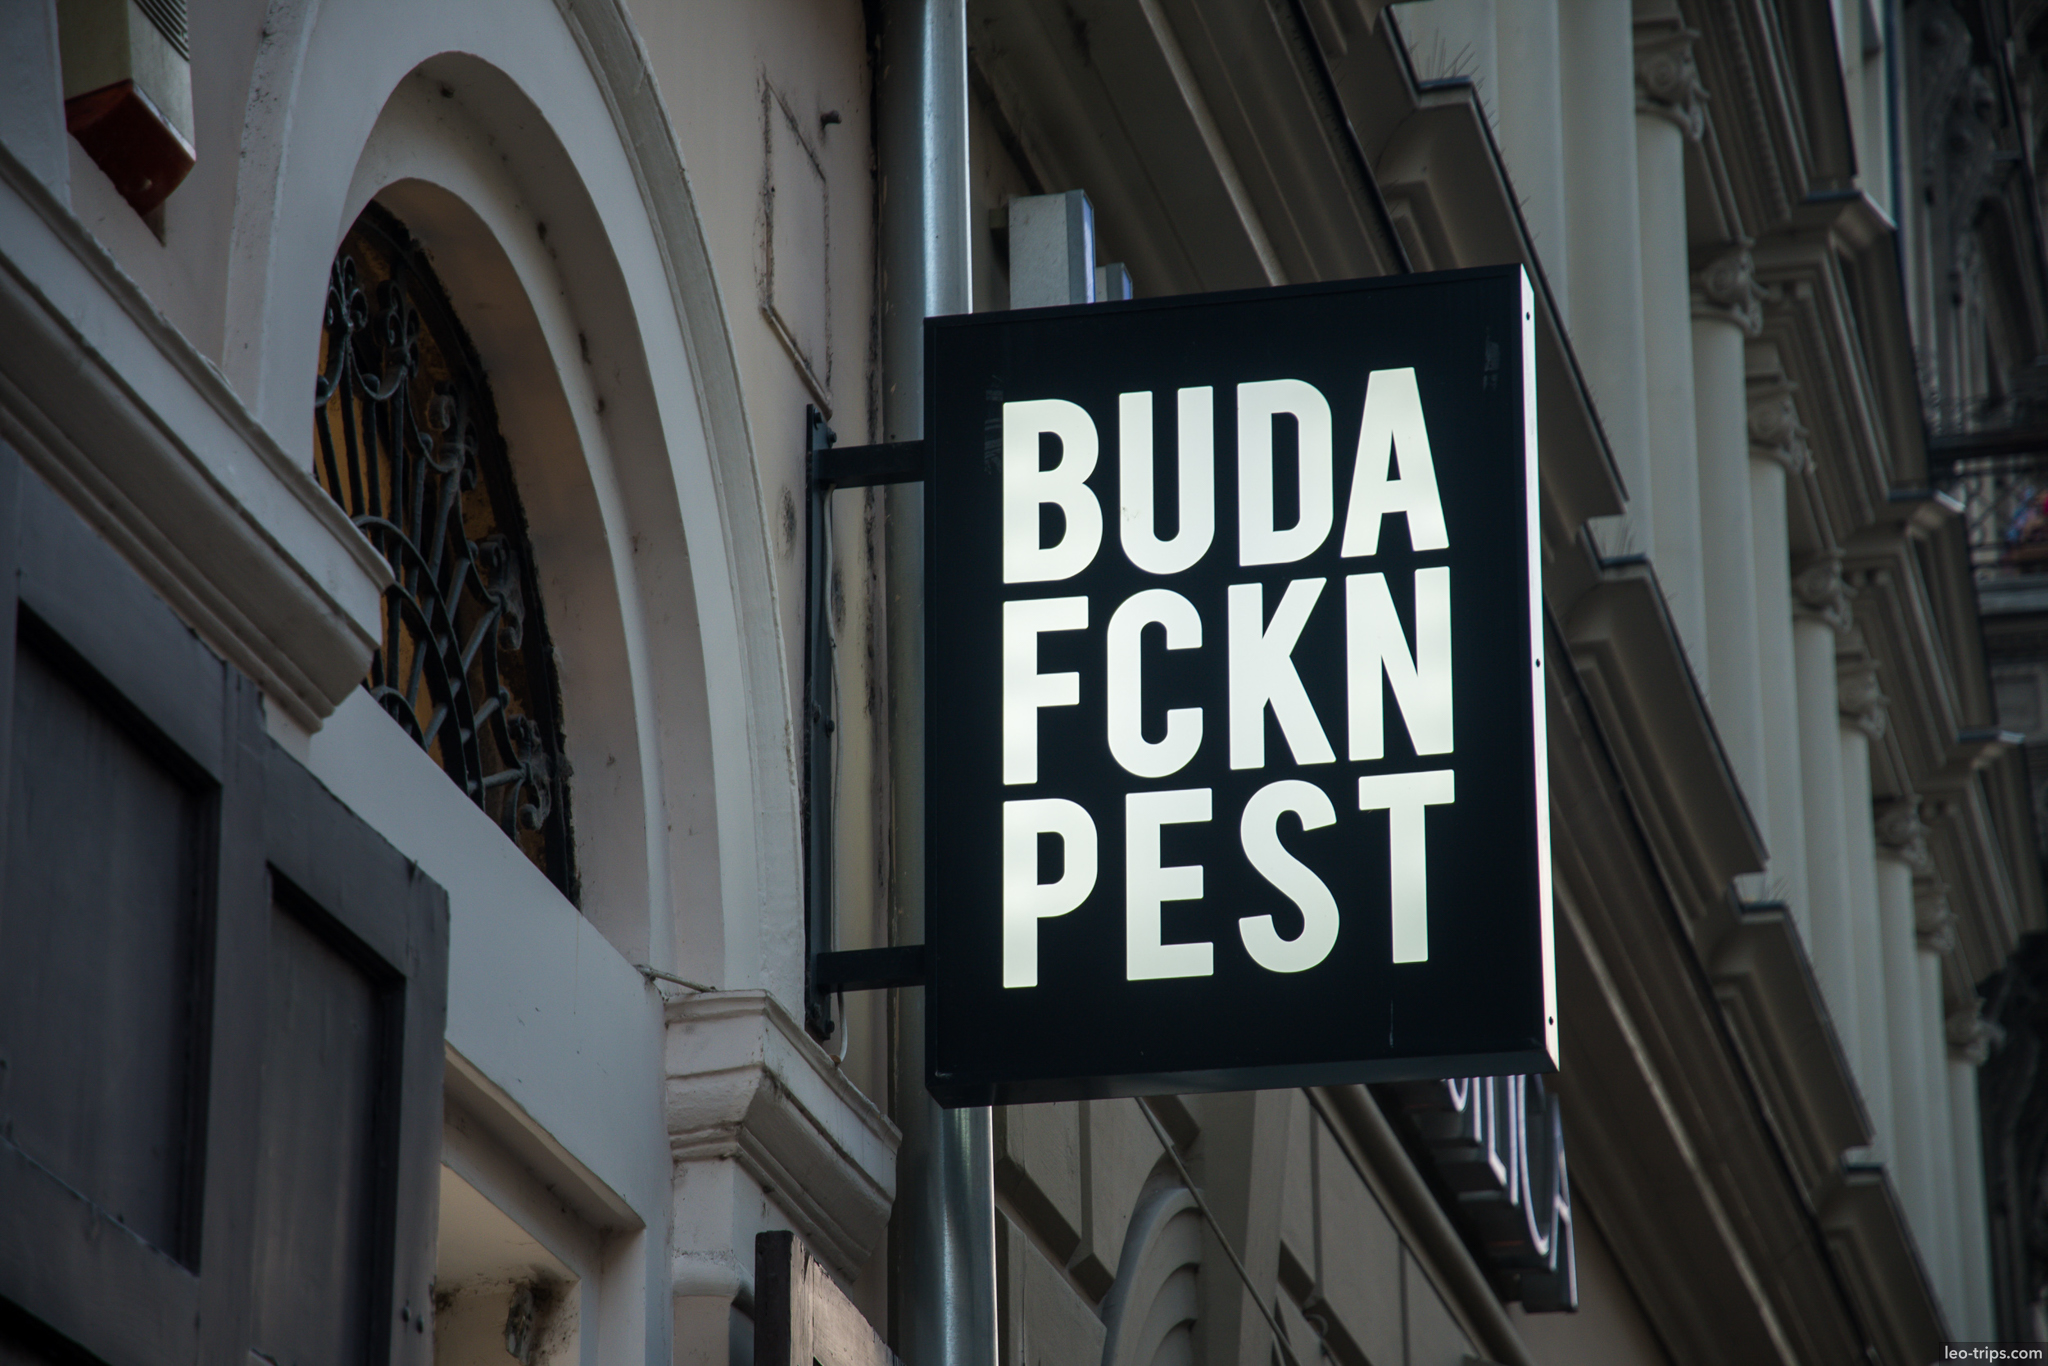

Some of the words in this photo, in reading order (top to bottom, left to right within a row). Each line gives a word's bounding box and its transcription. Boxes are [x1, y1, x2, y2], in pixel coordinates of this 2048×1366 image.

[1002, 366, 1450, 584] BUDA
[1002, 565, 1454, 786] FCKN
[1002, 769, 1455, 989] PEST
